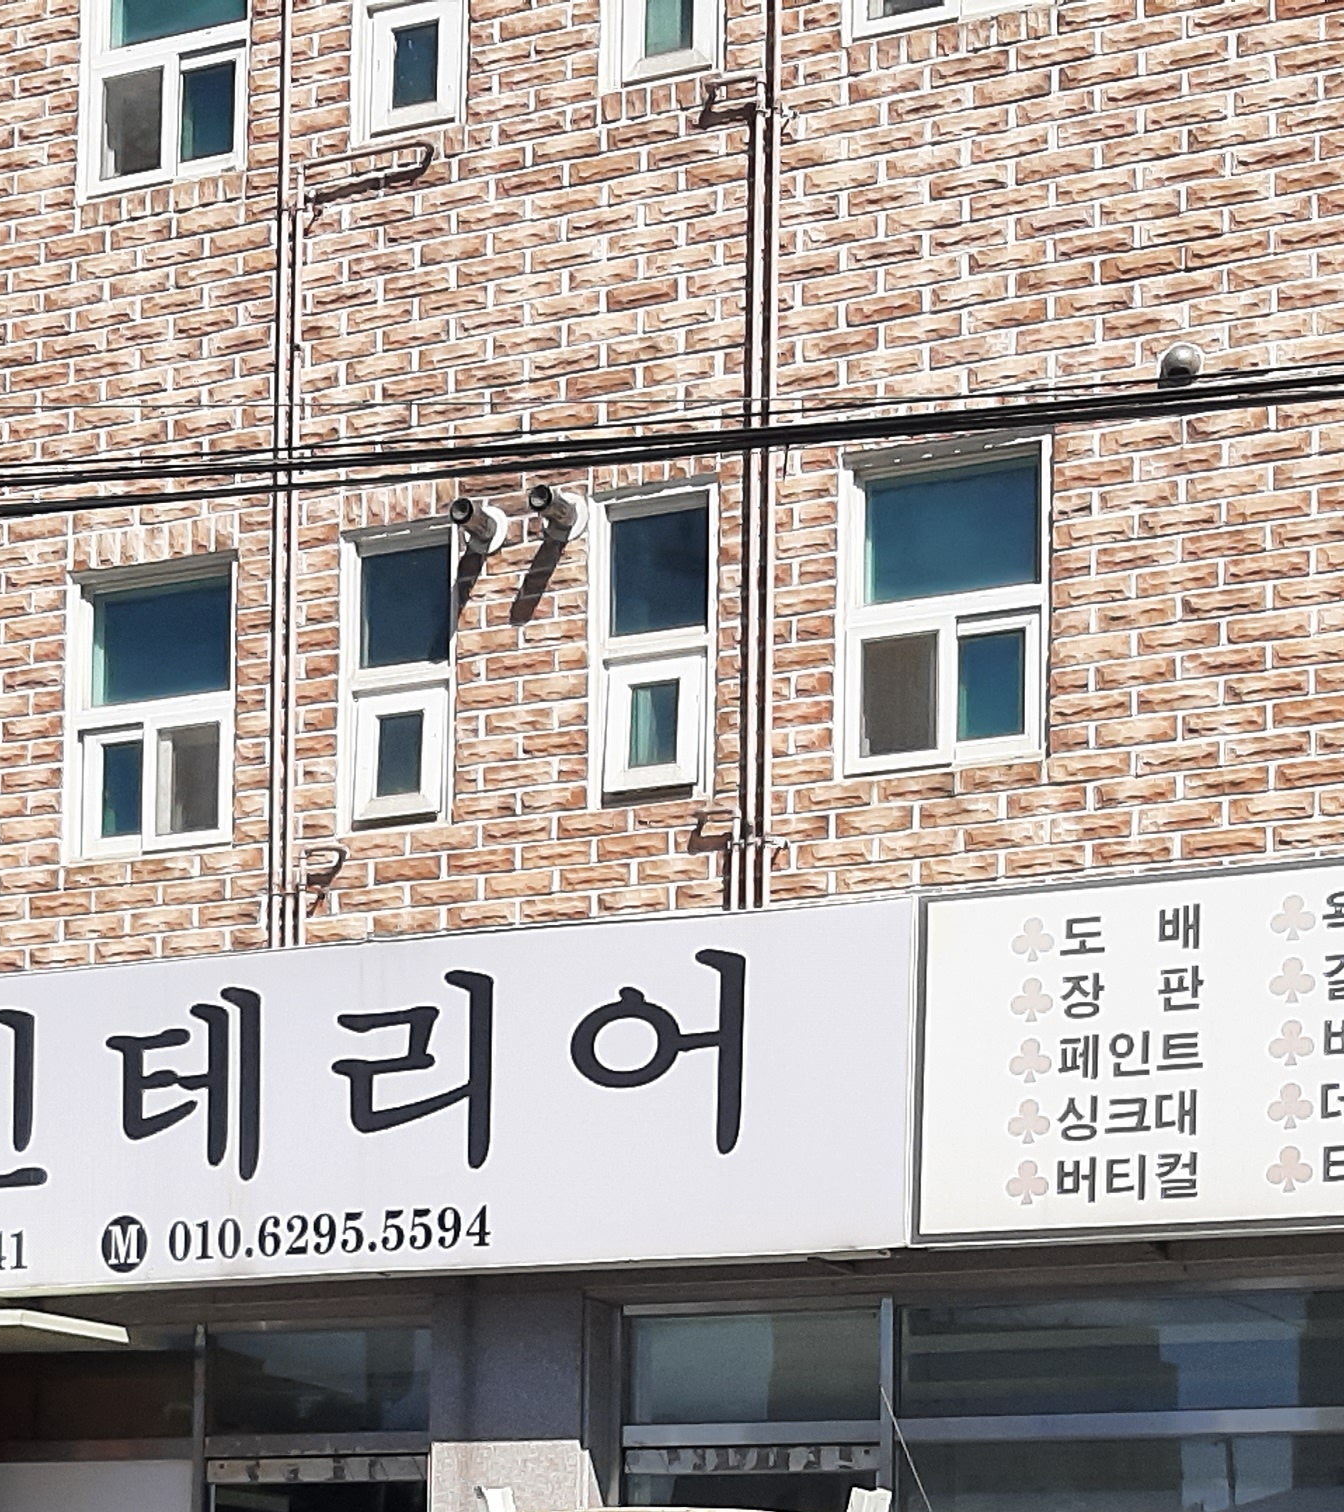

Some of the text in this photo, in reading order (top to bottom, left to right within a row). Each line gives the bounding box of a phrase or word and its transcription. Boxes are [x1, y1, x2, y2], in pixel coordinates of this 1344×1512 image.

[1058, 1029, 1204, 1080] 페인트
[1056, 1088, 1199, 1142] 싱크대
[1055, 1150, 1200, 1204] 버티컬
[168, 1205, 492, 1262] 010.6295.5594
